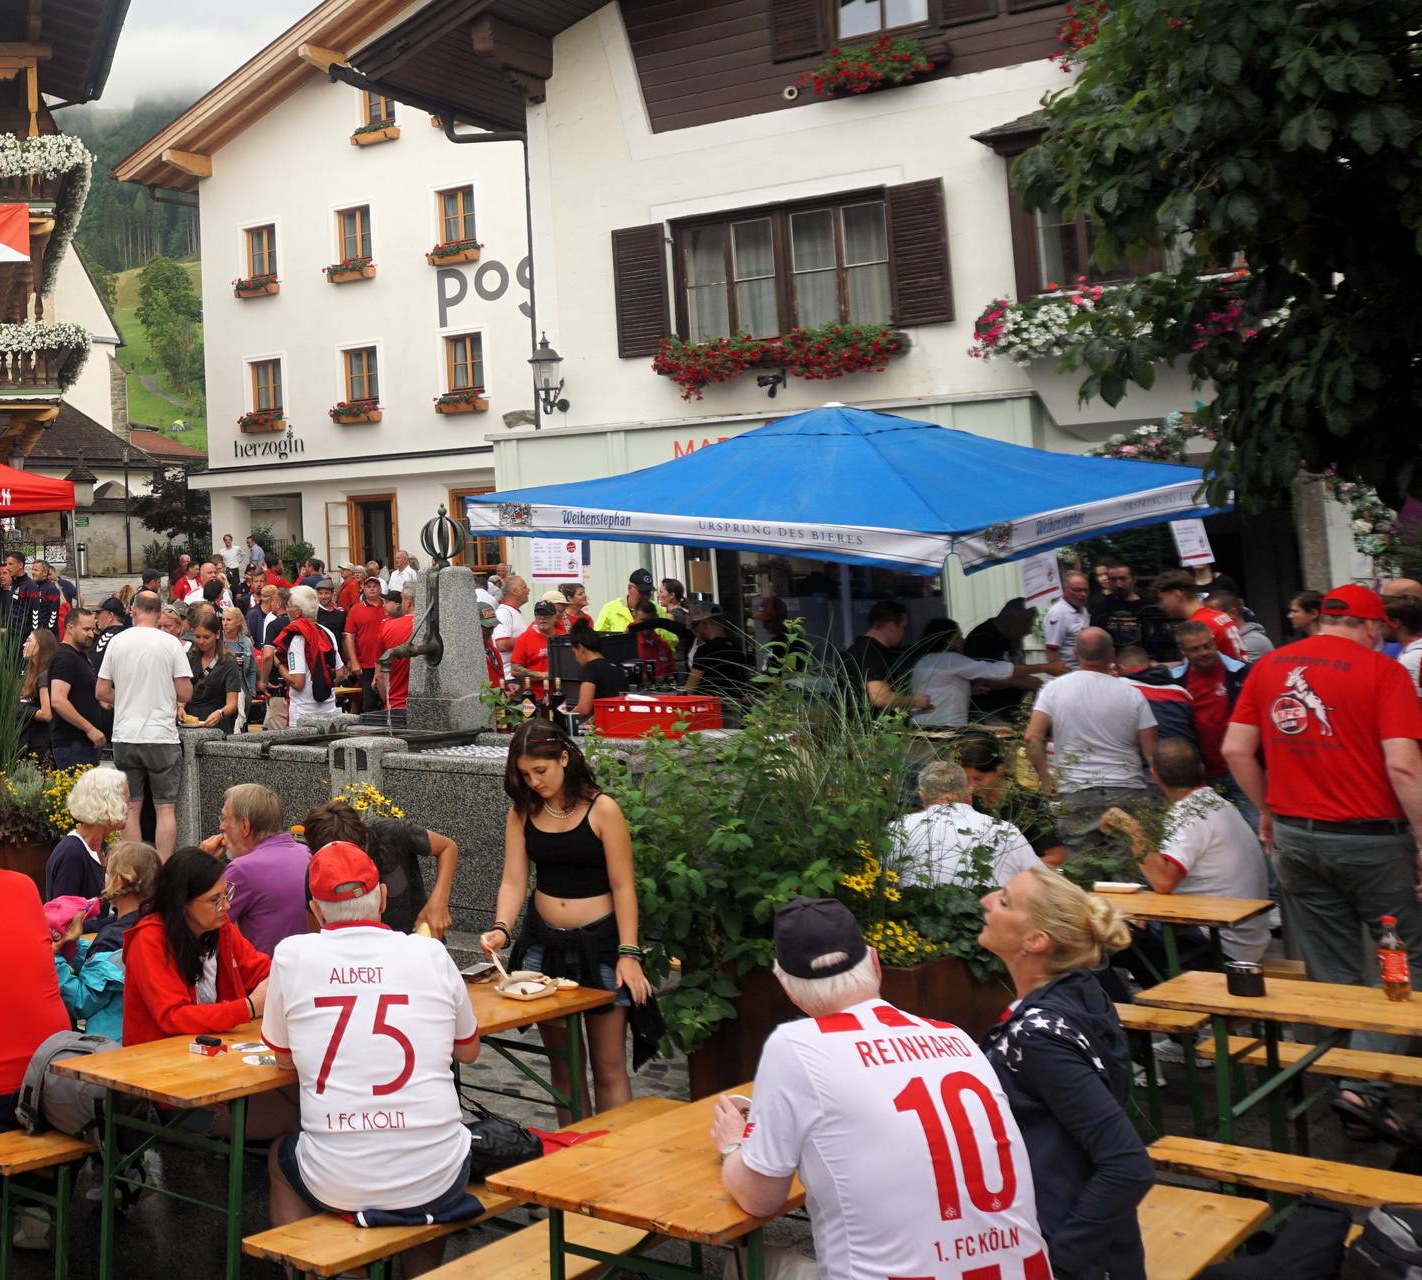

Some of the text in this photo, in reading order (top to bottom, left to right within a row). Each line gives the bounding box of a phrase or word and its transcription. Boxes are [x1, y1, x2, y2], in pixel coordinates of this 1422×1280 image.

[234, 428, 305, 460] herzogin
[561, 509, 631, 529] Weihenstephan
[698, 520, 864, 546] URSPRUNG DES BIERES
[329, 967, 384, 984] ALBERT
[313, 994, 416, 1096] 75
[854, 1034, 973, 1068] REINHARD
[338, 1112, 356, 1130] FC
[362, 1110, 407, 1130] KÖLN
[893, 1070, 1018, 1222] 10
[933, 1226, 1020, 1263] 1. FC KÖLN
